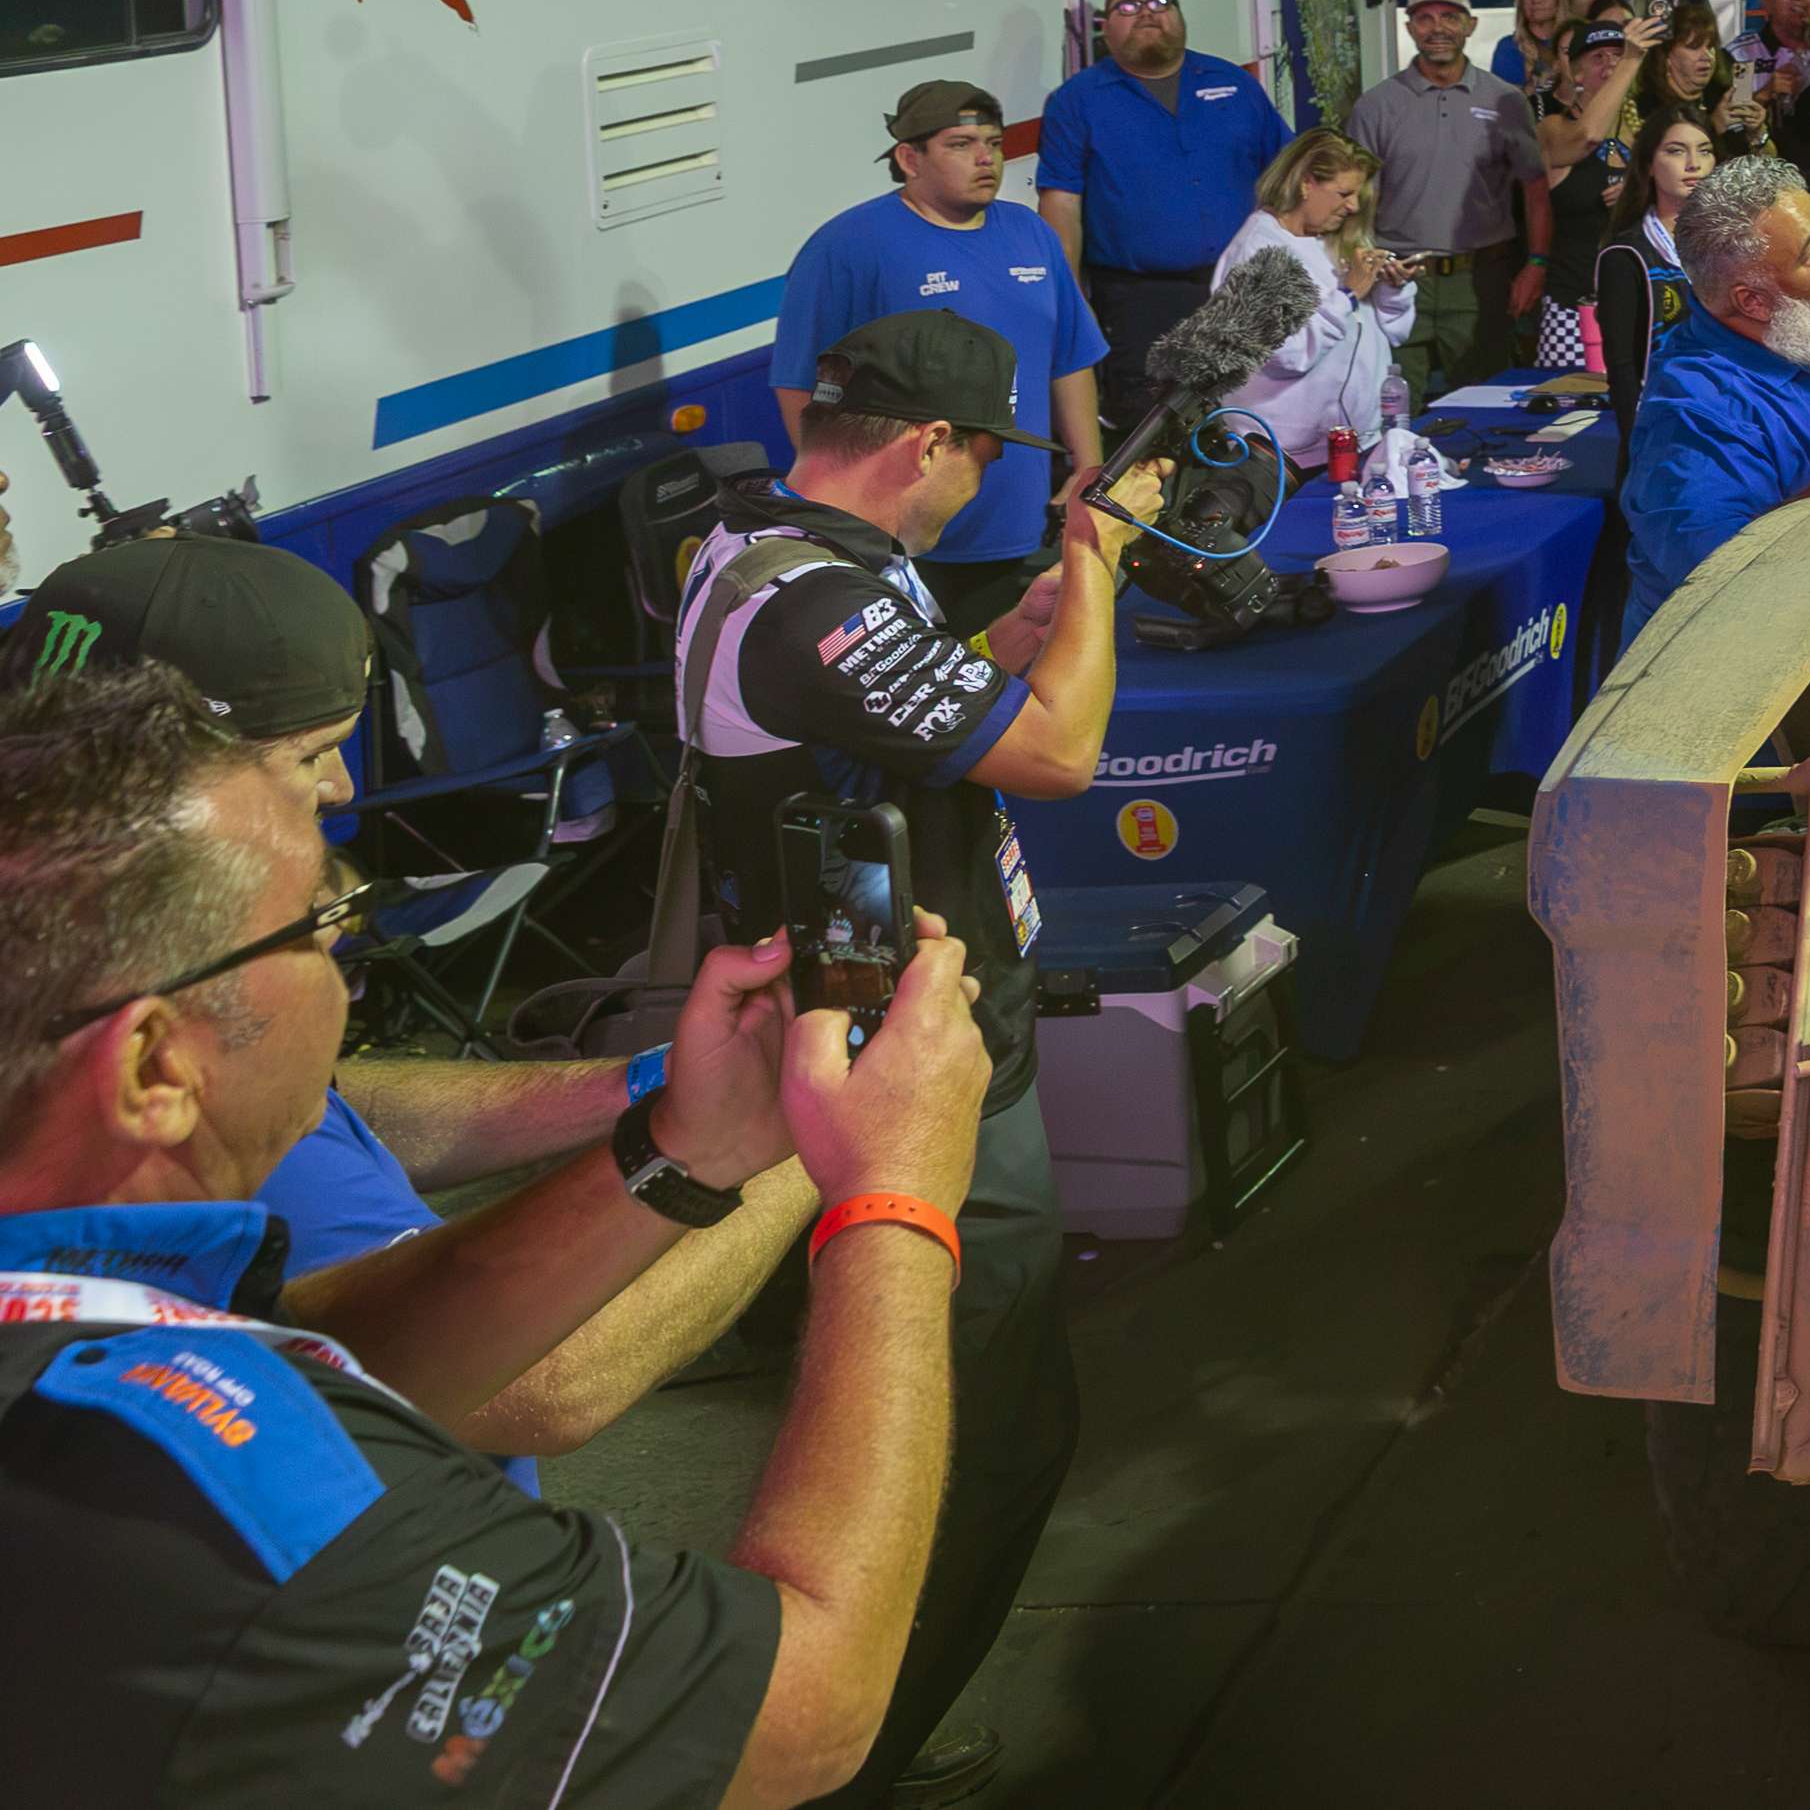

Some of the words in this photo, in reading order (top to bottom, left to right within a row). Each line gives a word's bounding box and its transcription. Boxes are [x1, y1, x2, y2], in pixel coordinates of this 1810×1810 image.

[861, 597, 898, 632] 83
[837, 618, 908, 674] METHOD
[913, 696, 963, 742] FOX
